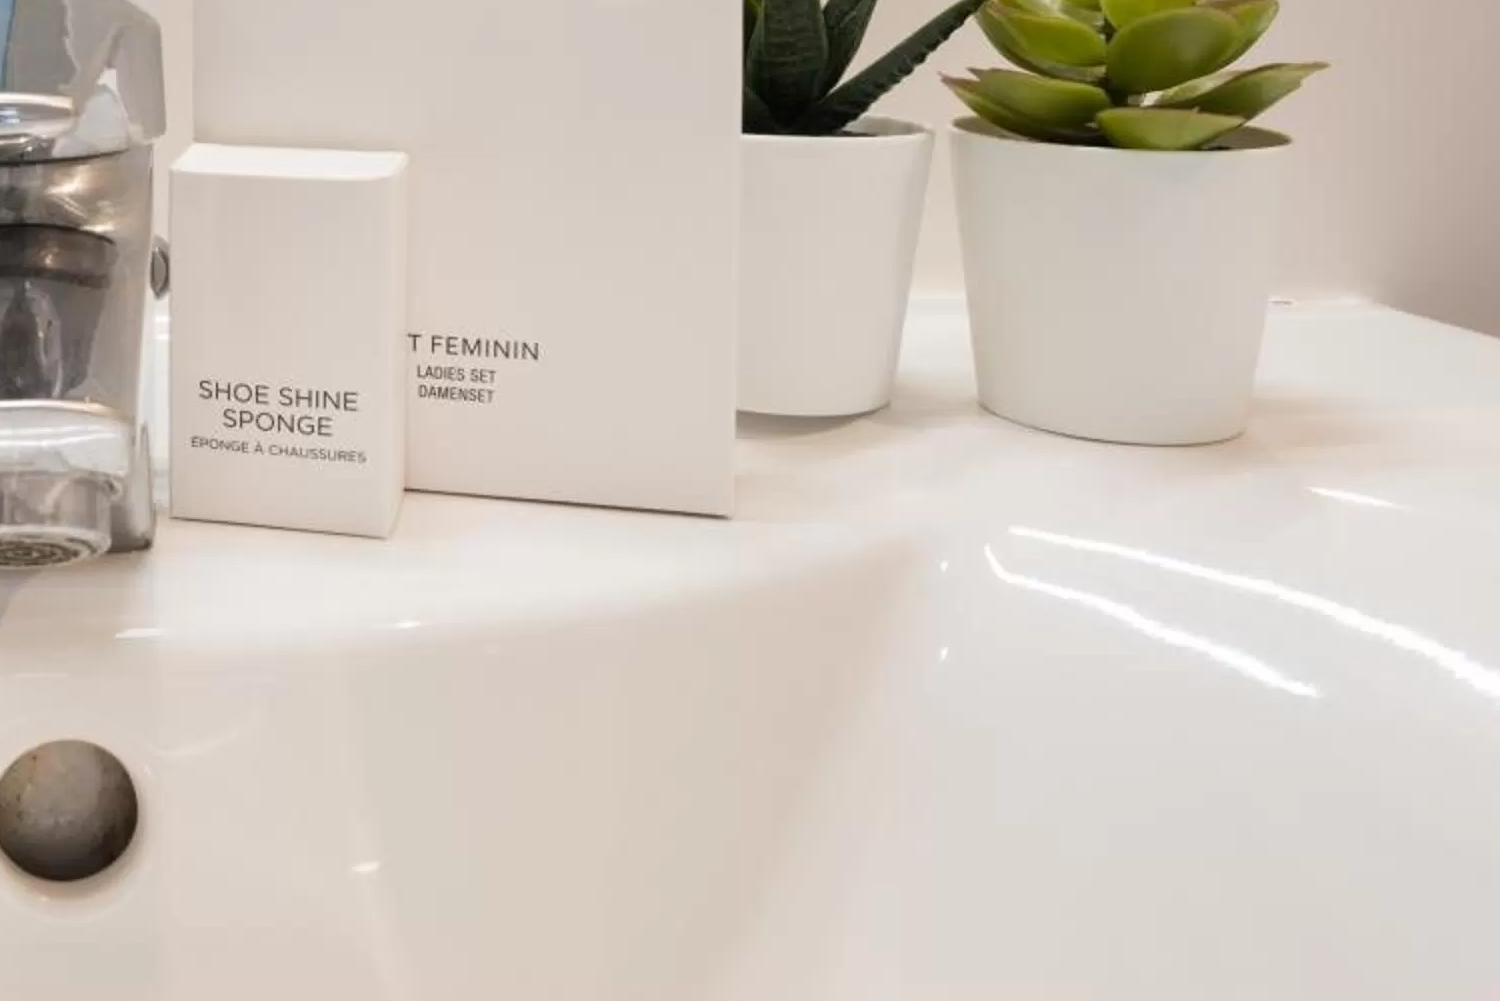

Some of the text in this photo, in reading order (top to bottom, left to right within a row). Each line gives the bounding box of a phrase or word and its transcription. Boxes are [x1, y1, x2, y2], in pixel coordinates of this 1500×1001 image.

[431, 335, 539, 361] FEMININ
[416, 364, 497, 384] LADIES SET
[198, 380, 359, 412] SHOE SHINE
[417, 384, 495, 404] DAMENSET
[222, 408, 334, 437] SPONGE
[268, 444, 368, 464] CHAUSSURES
